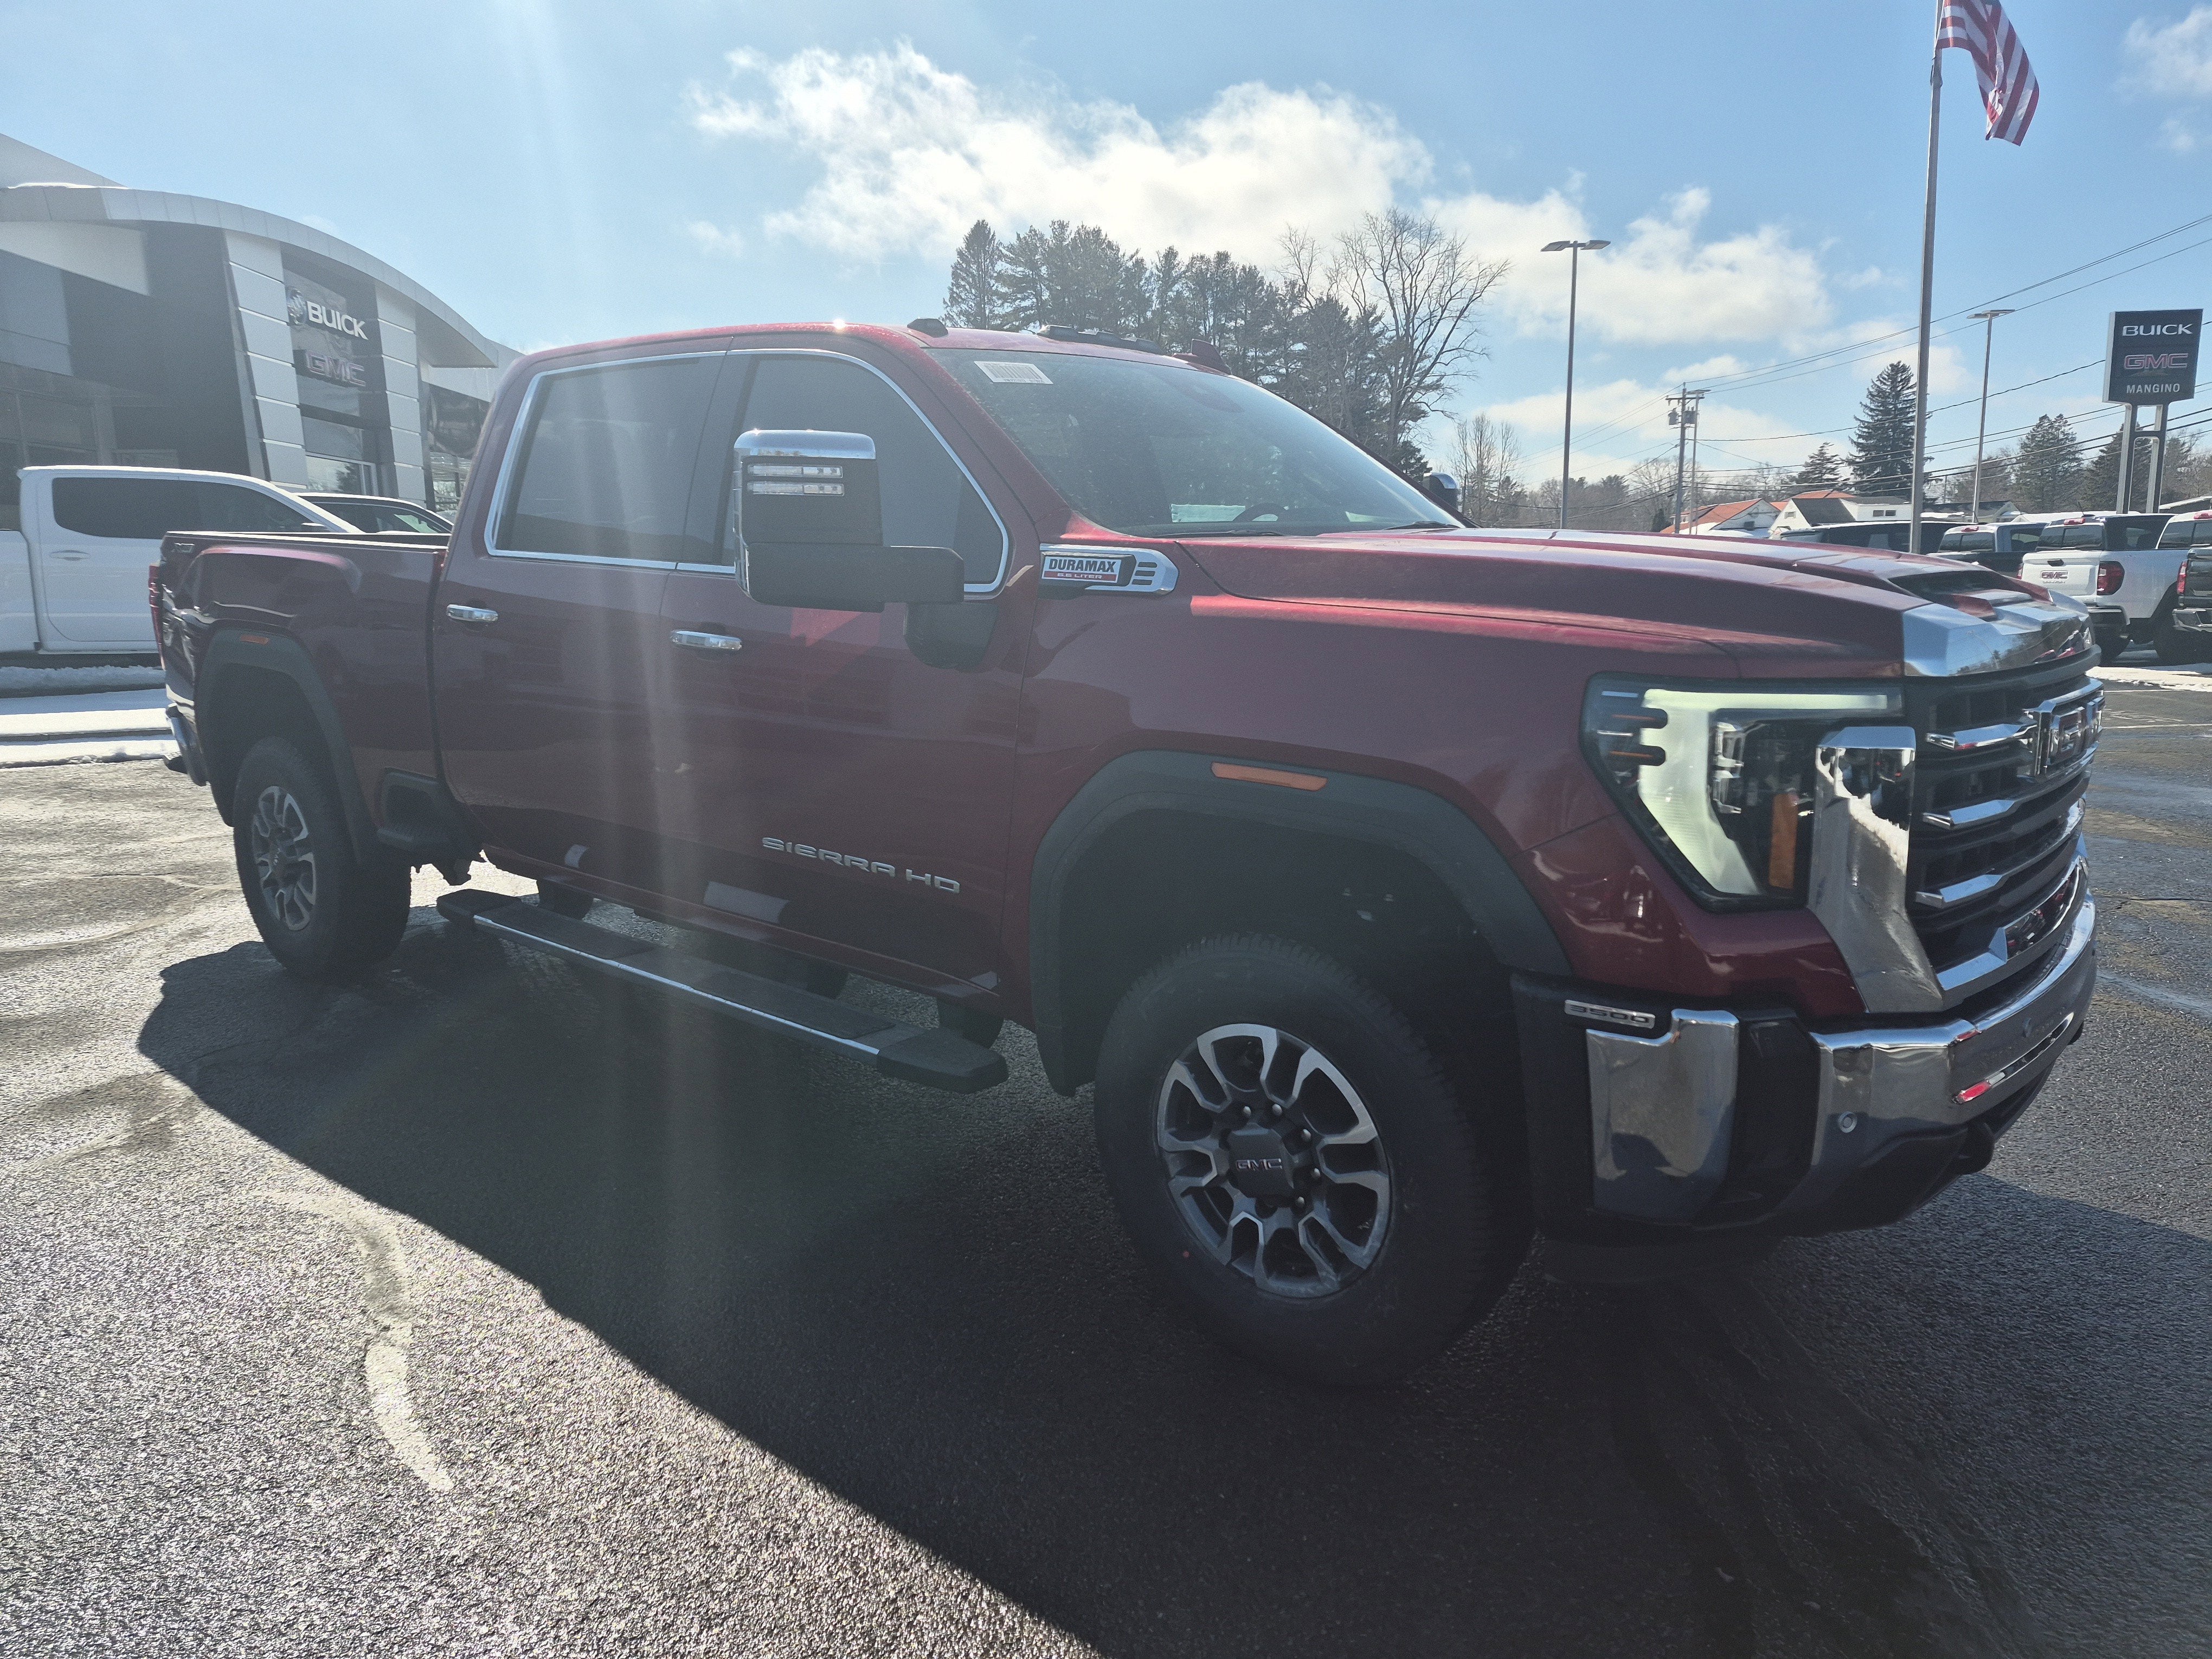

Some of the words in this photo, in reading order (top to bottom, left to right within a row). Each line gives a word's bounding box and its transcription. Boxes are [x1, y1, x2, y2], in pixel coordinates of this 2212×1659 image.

[307, 301, 369, 340] BUICK
[2122, 323, 2194, 337] BUICK
[305, 350, 366, 387] GMC
[2124, 353, 2189, 370] GMC
[2126, 383, 2181, 394] MANGINO
[1049, 558, 1117, 573] DURAMAX
[762, 837, 896, 878] SIERRA
[905, 869, 961, 894] HD
[1570, 1005, 1650, 1024] 3500
[1236, 1158, 1283, 1171] GMC
